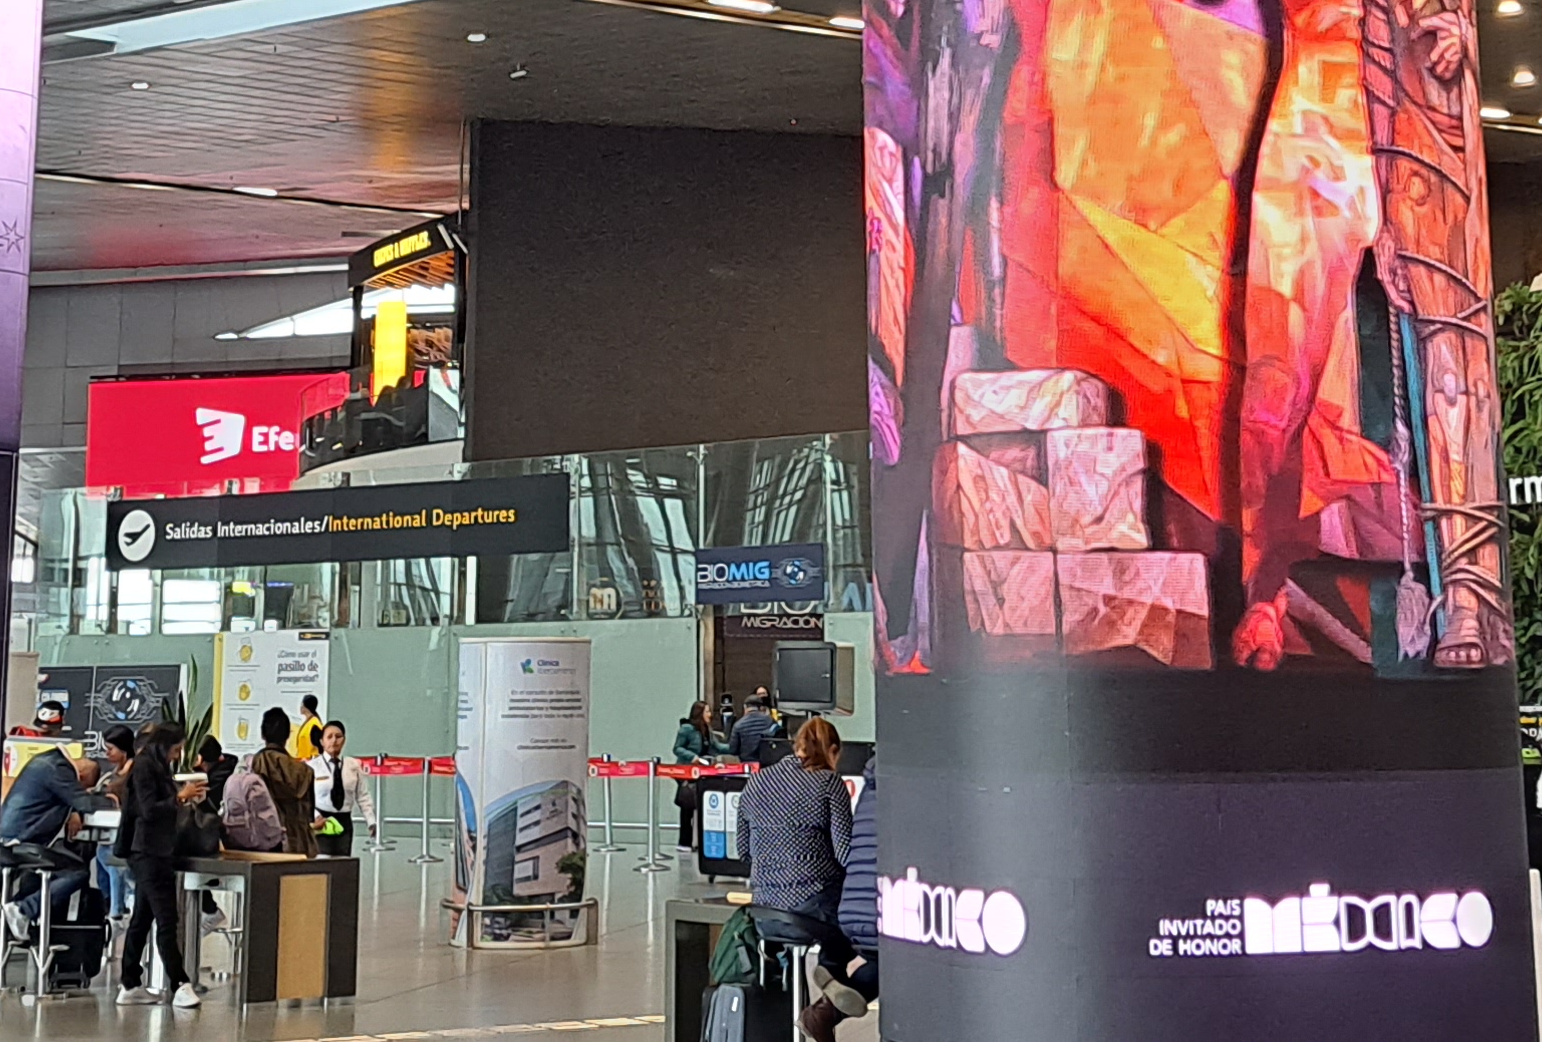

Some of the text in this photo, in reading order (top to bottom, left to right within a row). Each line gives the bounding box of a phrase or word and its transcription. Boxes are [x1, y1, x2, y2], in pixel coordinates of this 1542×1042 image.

[251, 424, 299, 452] Efe
[165, 523, 213, 540] Salidas
[432, 507, 516, 531] Departures
[697, 560, 772, 583] BIOMIG
[741, 616, 824, 629] MIGRACIÓN
[277, 660, 306, 675] pasillo
[307, 660, 319, 672] de
[1205, 897, 1241, 916] PAÍS
[1159, 919, 1242, 937] INVITADO
[1149, 938, 1243, 956] DE HONOR
